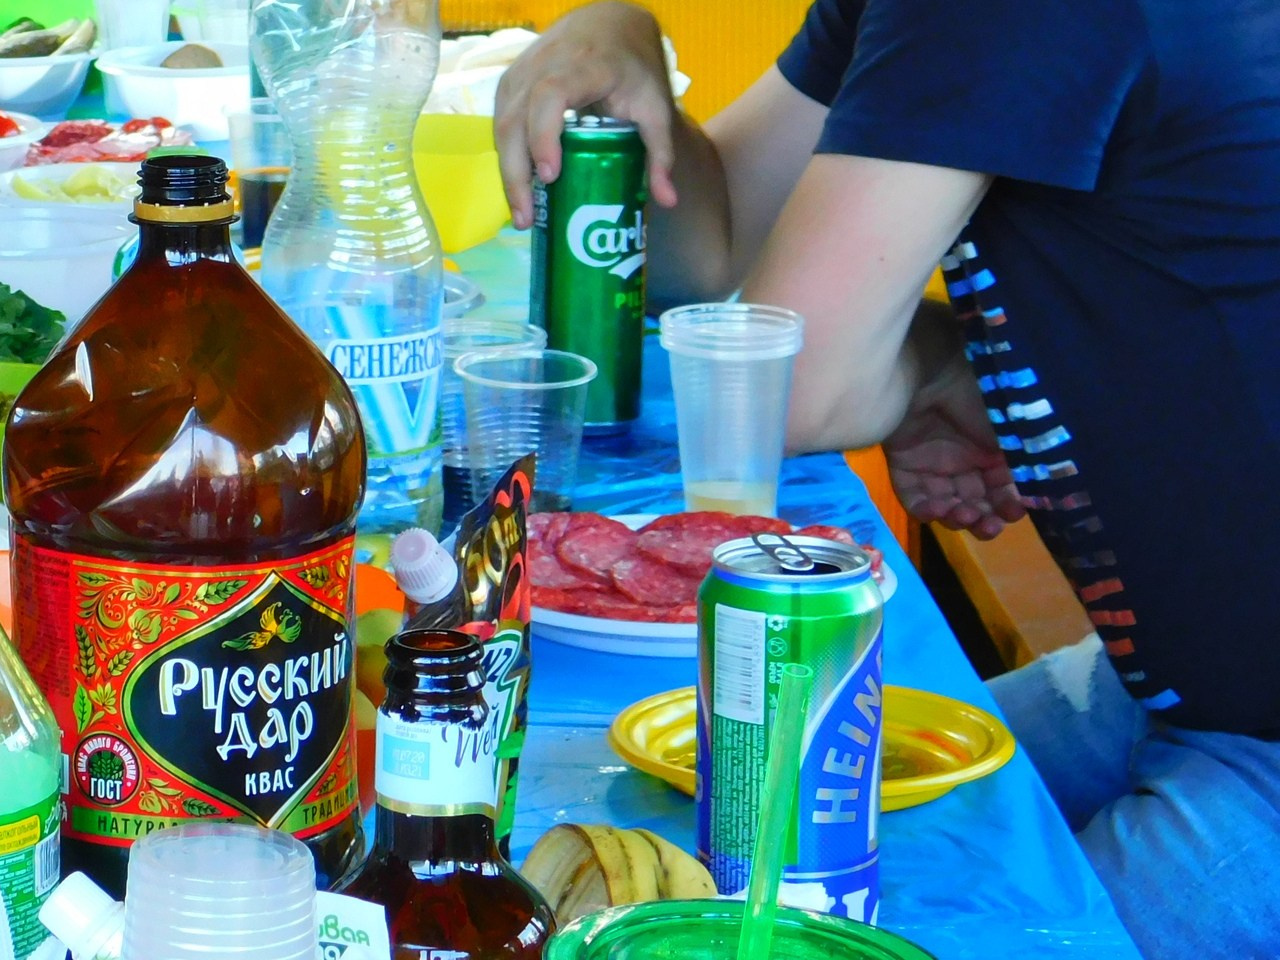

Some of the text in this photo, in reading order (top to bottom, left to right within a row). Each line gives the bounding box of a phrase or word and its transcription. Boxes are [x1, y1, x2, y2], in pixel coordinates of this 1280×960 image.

[159, 632, 347, 734] Русский
[90, 777, 123, 801] ГОСТ
[244, 766, 295, 797] КВАС
